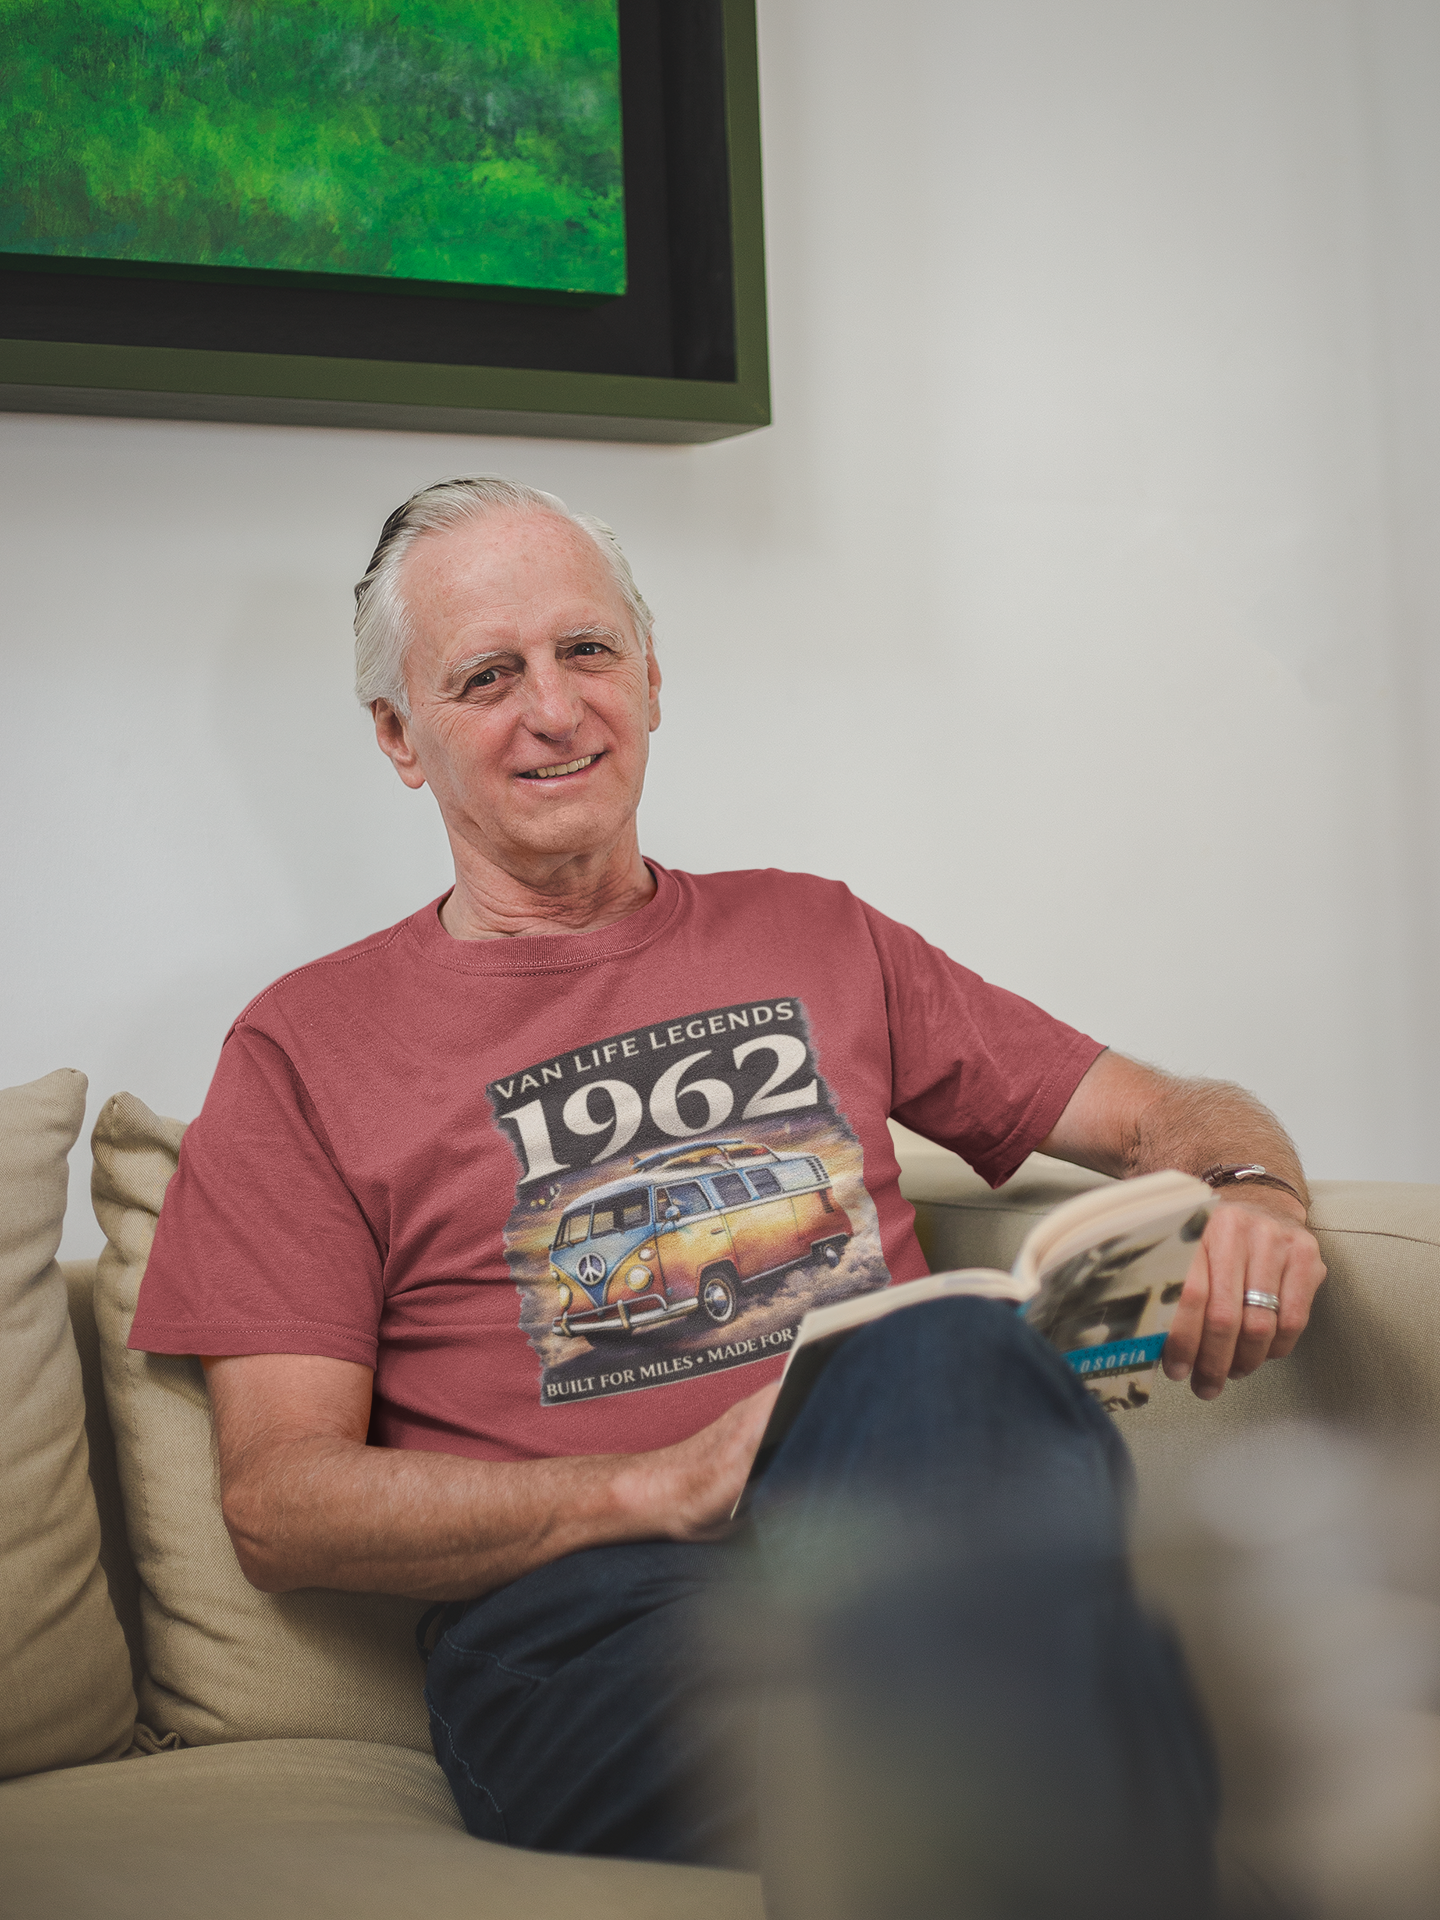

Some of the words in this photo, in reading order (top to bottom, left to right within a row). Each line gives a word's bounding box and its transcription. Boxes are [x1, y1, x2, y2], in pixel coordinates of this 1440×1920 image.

[494, 1062, 563, 1099] VAN
[573, 1037, 639, 1073] LIFE
[649, 1002, 794, 1050] LEGENDS
[500, 1034, 818, 1185] 1962
[546, 1376, 595, 1397] BUILT
[600, 1369, 636, 1388] FOR
[639, 1355, 694, 1379] MILES
[707, 1339, 758, 1362] MADE
[760, 1327, 794, 1348] FOR
[1071, 1349, 1146, 1374] OSOFÍA
